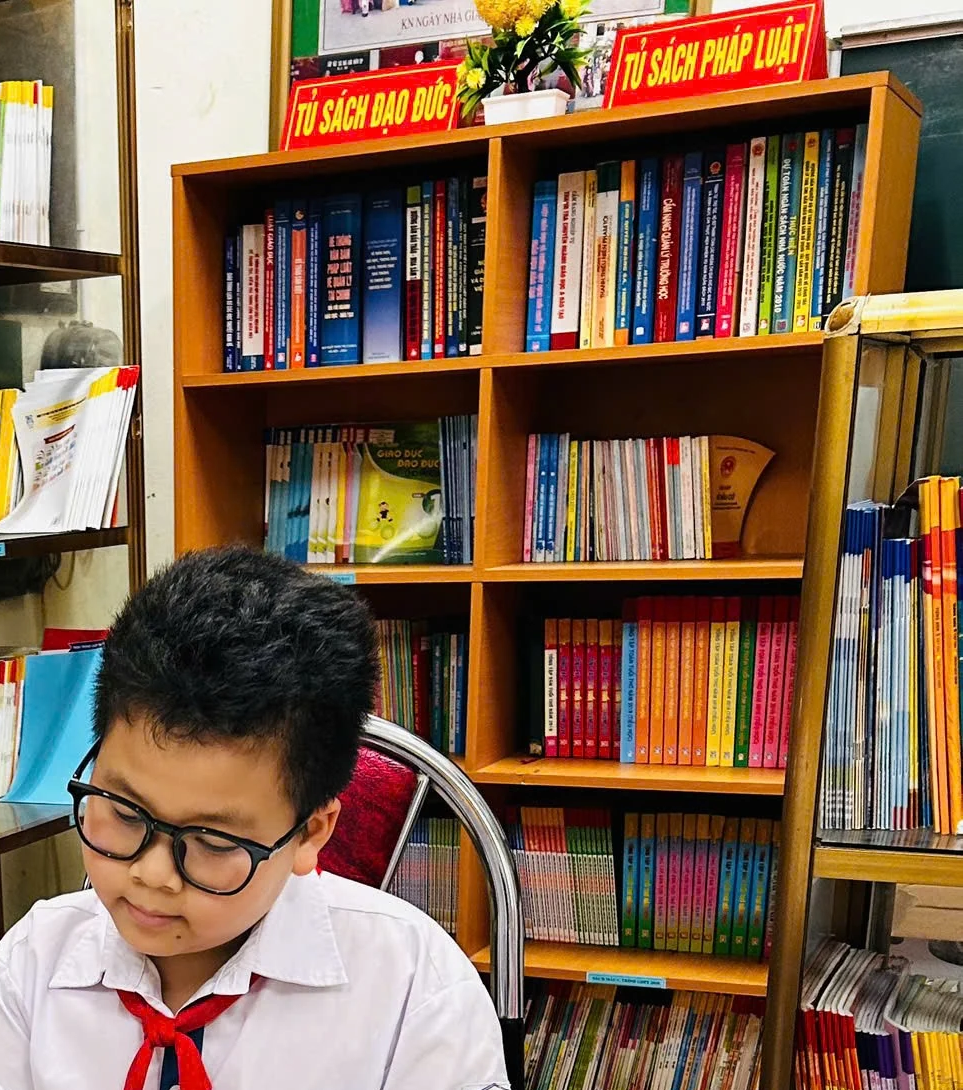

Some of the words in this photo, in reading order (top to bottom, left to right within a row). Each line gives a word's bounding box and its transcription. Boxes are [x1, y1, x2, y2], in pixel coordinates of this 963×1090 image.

[622, 38, 645, 90] TỦ
[648, 34, 696, 87] SÁCH
[699, 29, 752, 79] PHÁP
[755, 21, 805, 74] LUẬT
[294, 91, 318, 138] TỦ
[319, 87, 368, 134] SÁCH
[371, 90, 408, 135] ĐẠO
[411, 76, 450, 123] ĐỨC
